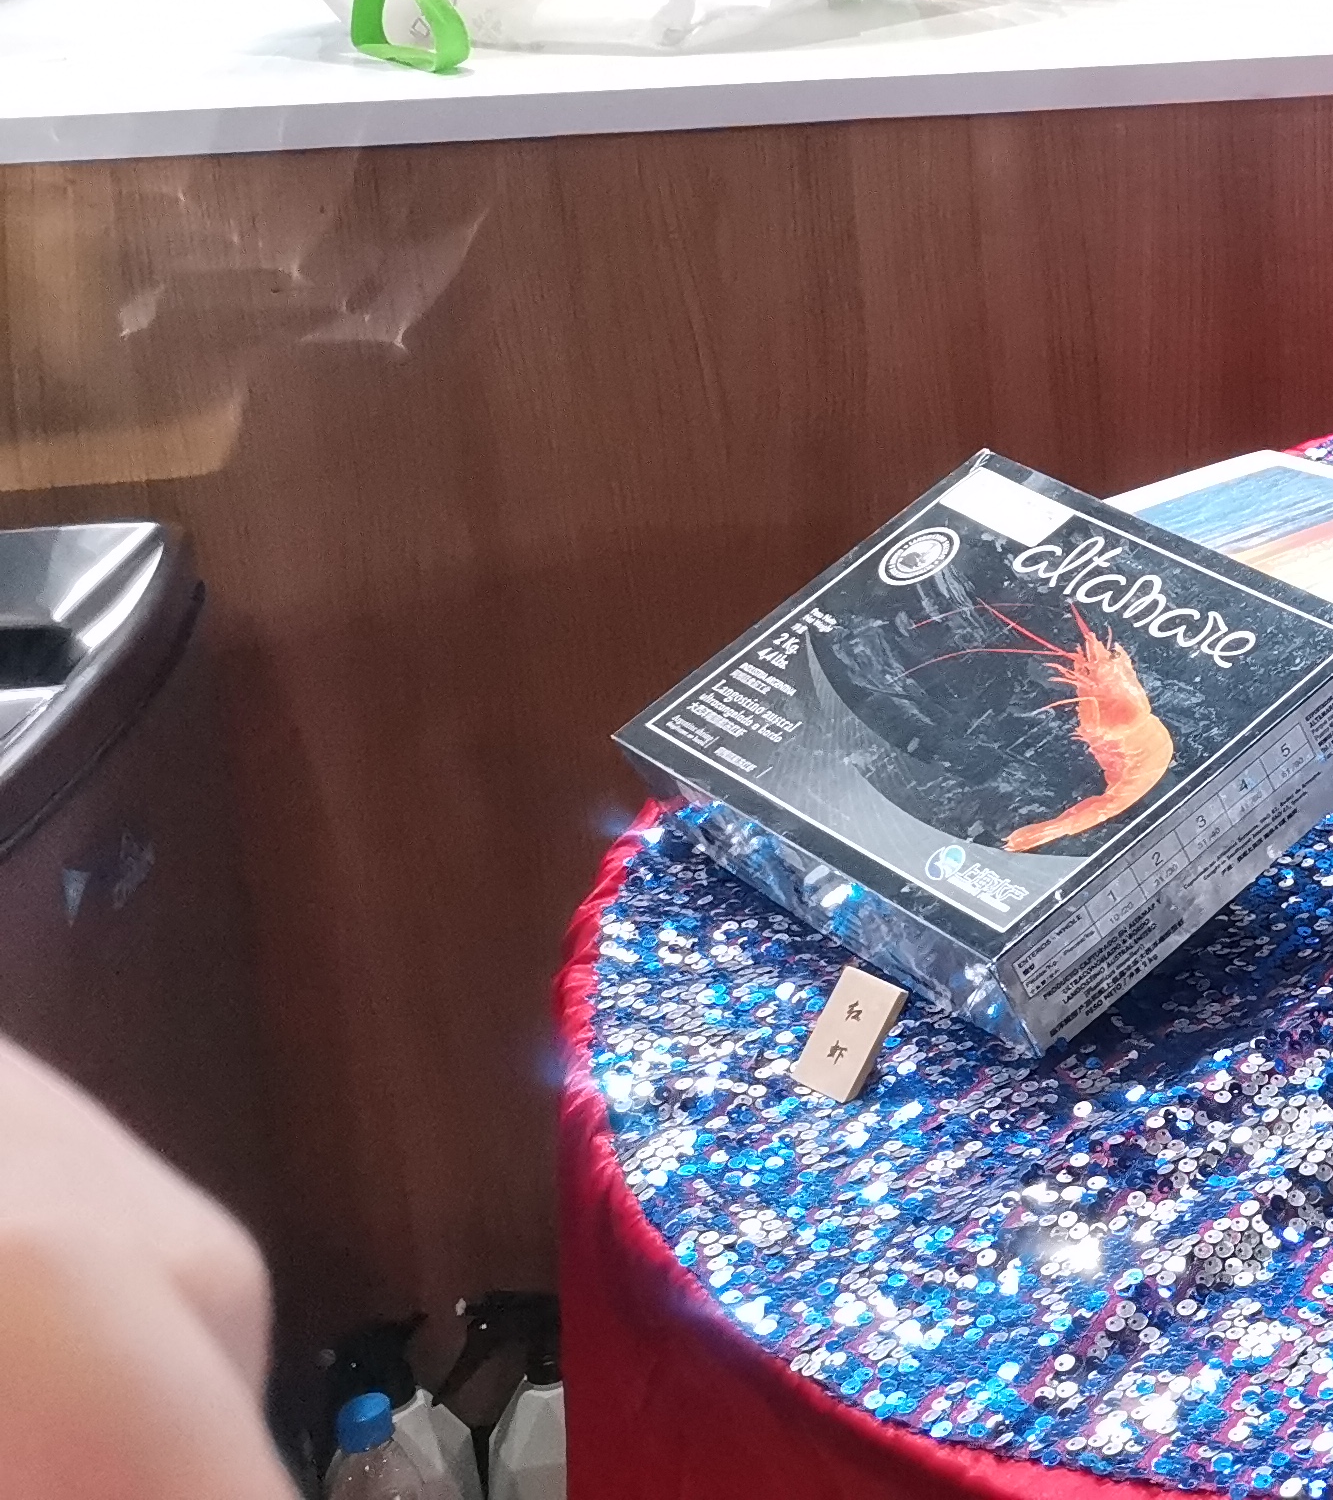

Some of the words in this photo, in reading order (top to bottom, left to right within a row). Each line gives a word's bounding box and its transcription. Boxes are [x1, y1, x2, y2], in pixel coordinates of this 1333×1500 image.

[711, 678, 765, 715] Langostino
[1279, 743, 1292, 758] 5
[1238, 778, 1250, 793] 4
[1195, 814, 1208, 829] 3
[1151, 850, 1166, 867] 2
[1107, 888, 1121, 903] 1
[826, 1000, 864, 1065] 红虾
